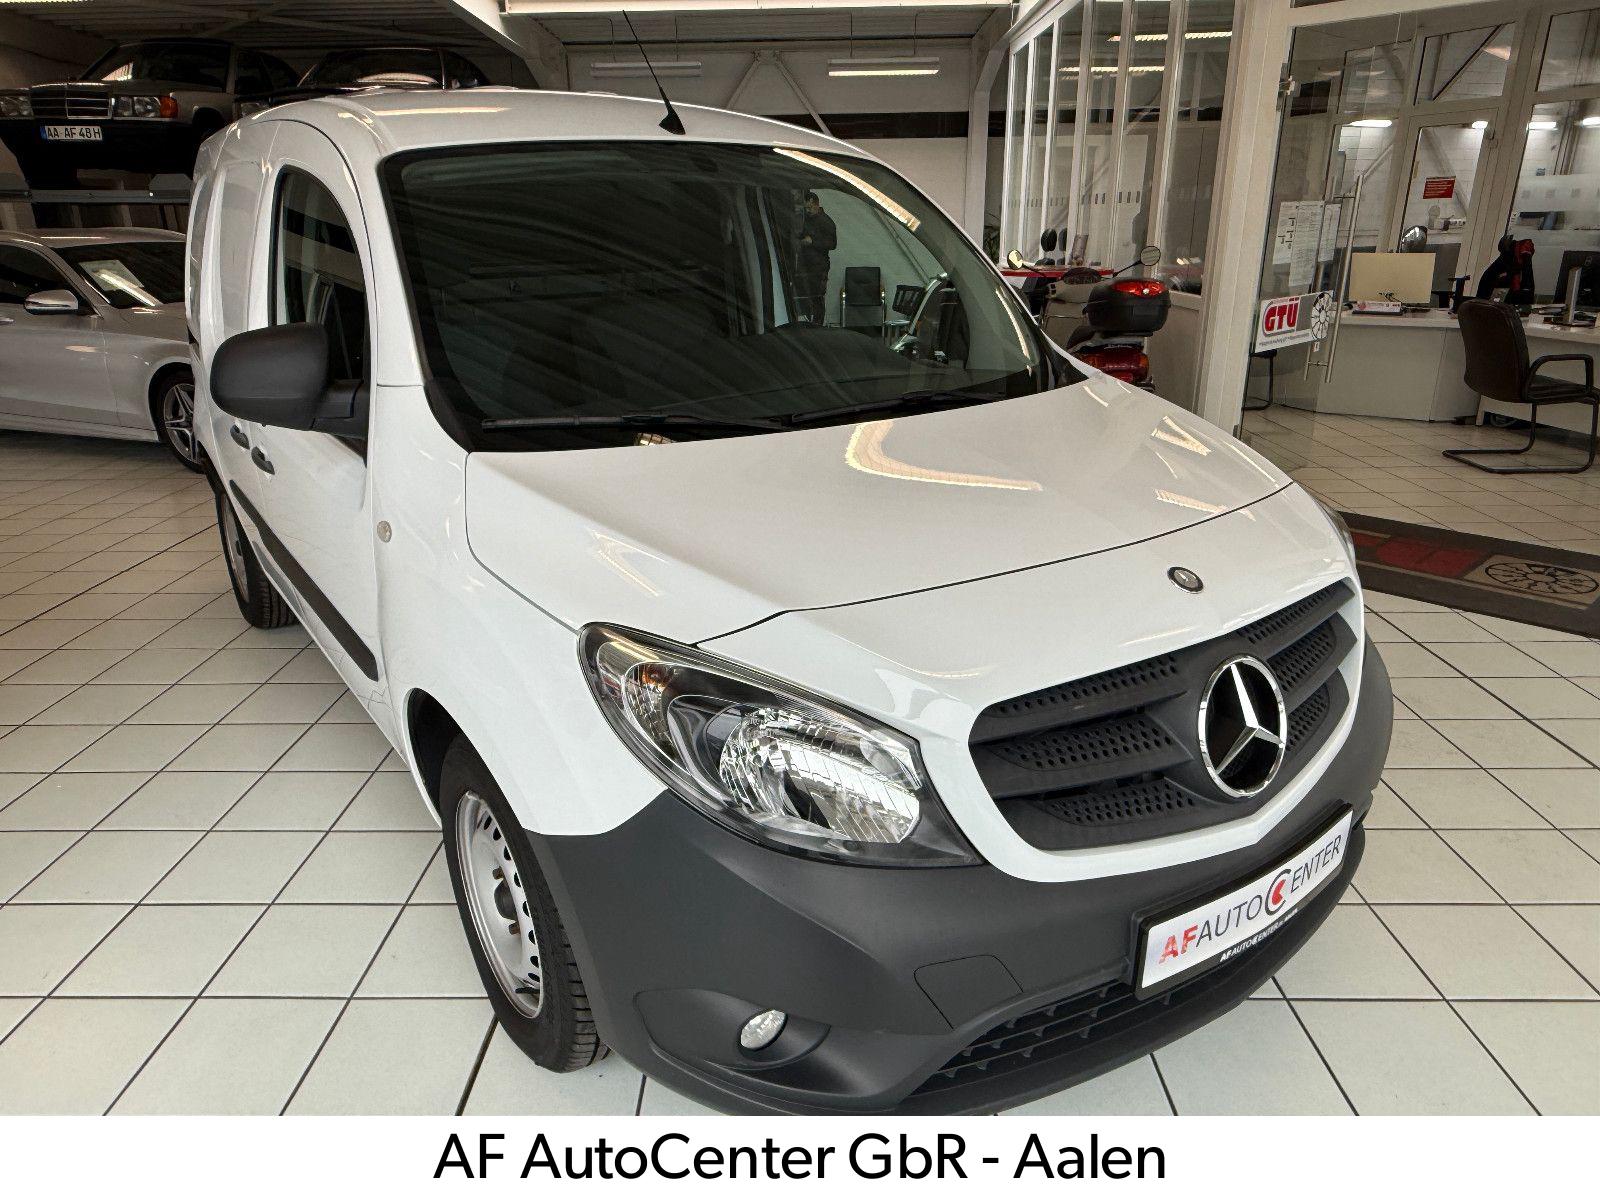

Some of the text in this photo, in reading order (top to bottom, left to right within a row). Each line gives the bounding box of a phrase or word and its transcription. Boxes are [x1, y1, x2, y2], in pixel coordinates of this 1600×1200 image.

[48, 127, 60, 139] AA
[64, 127, 77, 139] AF
[1264, 296, 1300, 332] GTÜ
[1158, 834, 1342, 965] AFAUTOCENTER
